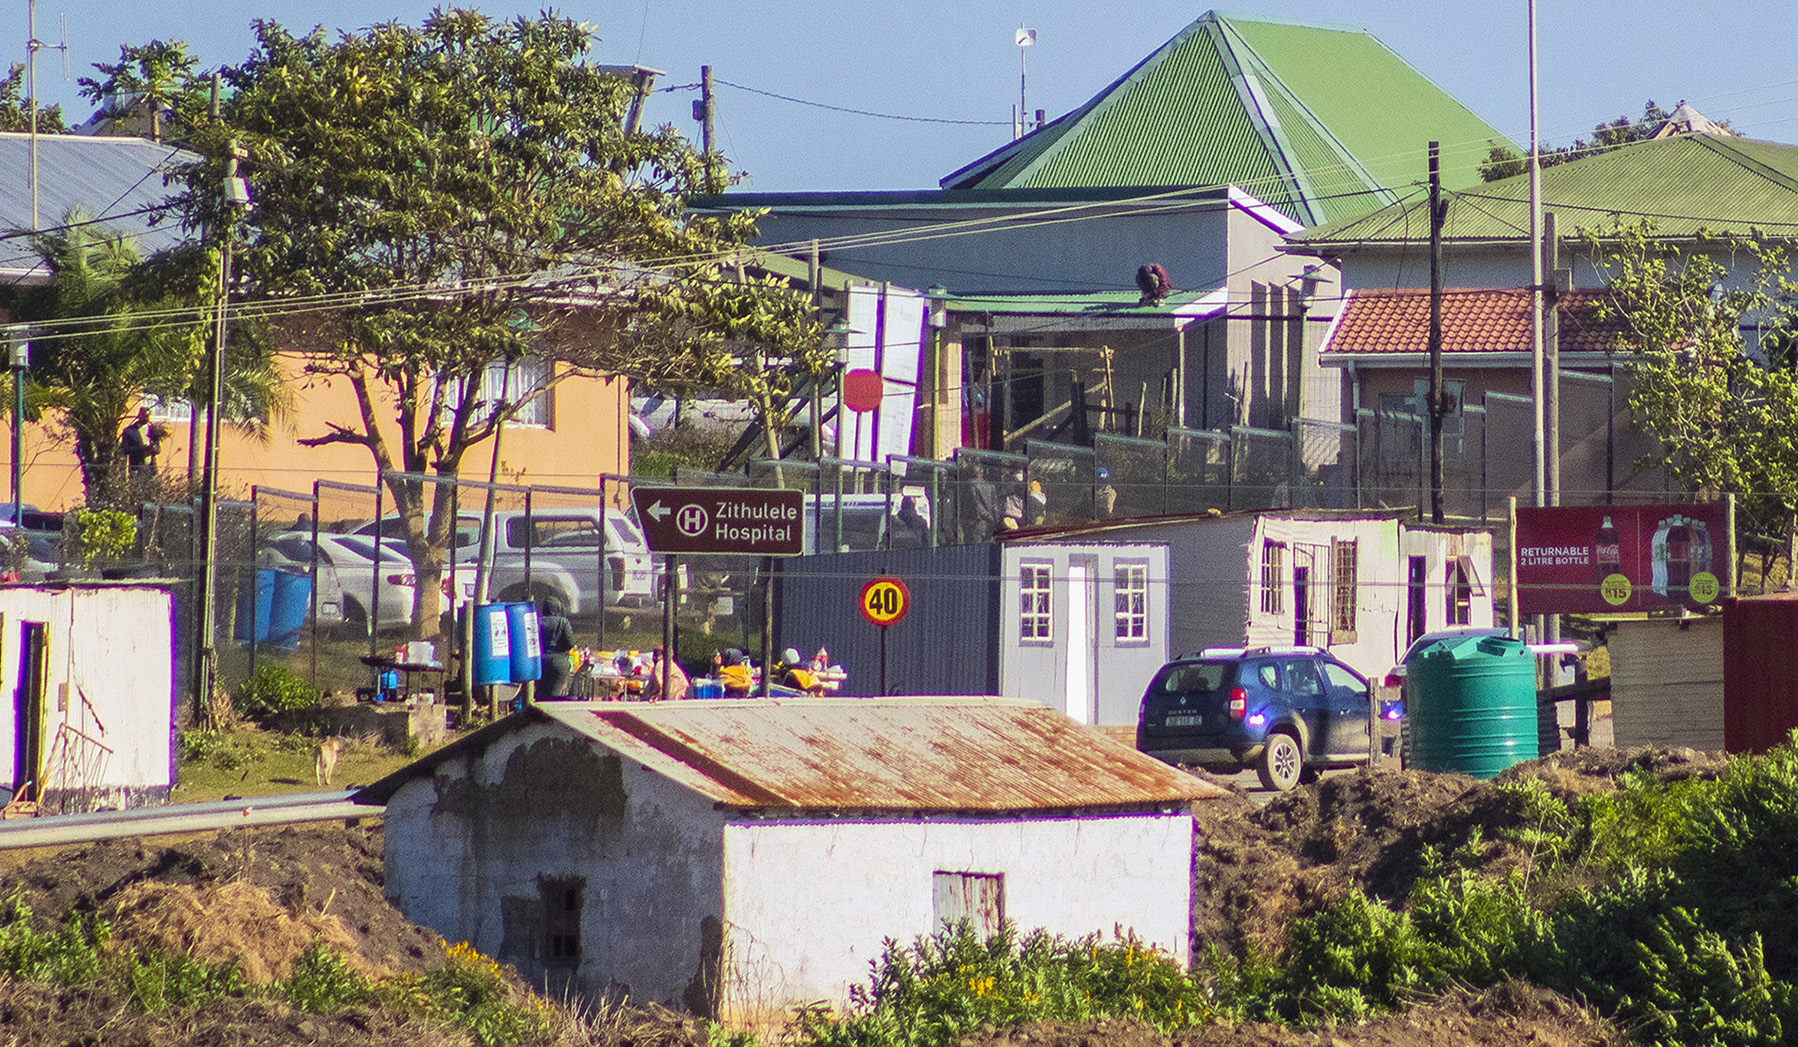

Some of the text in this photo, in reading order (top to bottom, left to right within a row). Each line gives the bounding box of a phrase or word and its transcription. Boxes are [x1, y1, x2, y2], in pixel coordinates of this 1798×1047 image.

[684, 509, 700, 530] H
[715, 501, 797, 519] Zithulele
[715, 522, 792, 545] Hospital
[1521, 546, 1589, 556] RETURNABLE
[1521, 556, 1589, 565] 2 LITRE BOTTLE
[869, 587, 898, 615] 40
